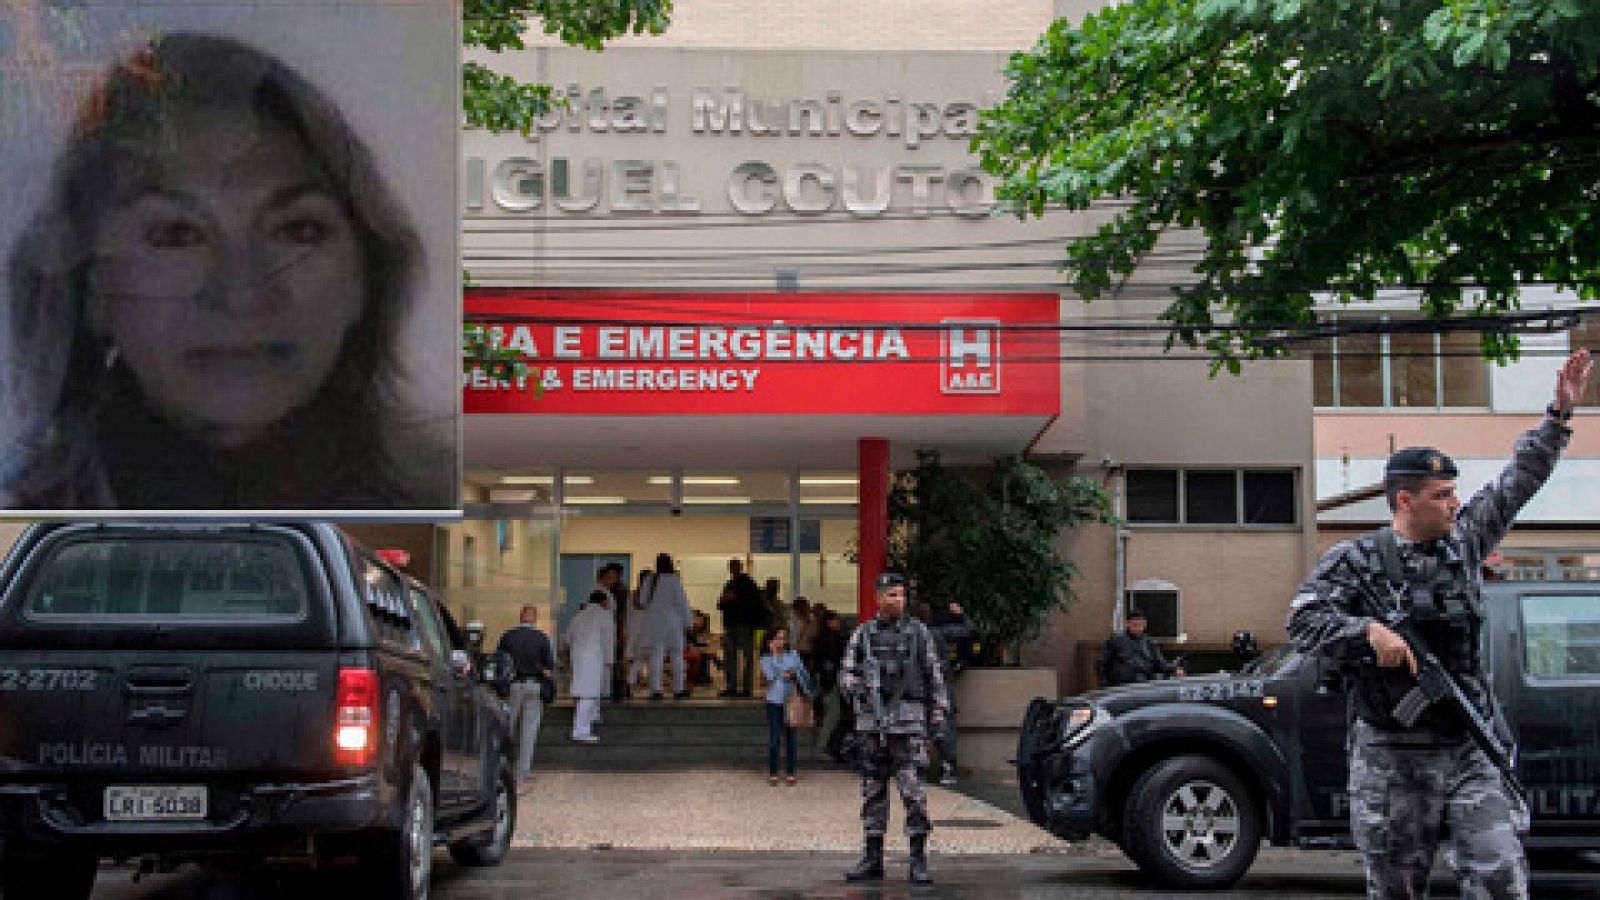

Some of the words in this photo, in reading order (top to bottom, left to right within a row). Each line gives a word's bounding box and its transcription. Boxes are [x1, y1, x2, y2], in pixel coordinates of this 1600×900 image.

[692, 85, 994, 150] Municipa
[727, 160, 996, 219] COUTO
[553, 325, 583, 359] E
[598, 319, 909, 360] EMERGÊNCIA
[949, 325, 991, 369] H
[542, 367, 564, 392] &
[572, 368, 760, 392] EMERGENCY
